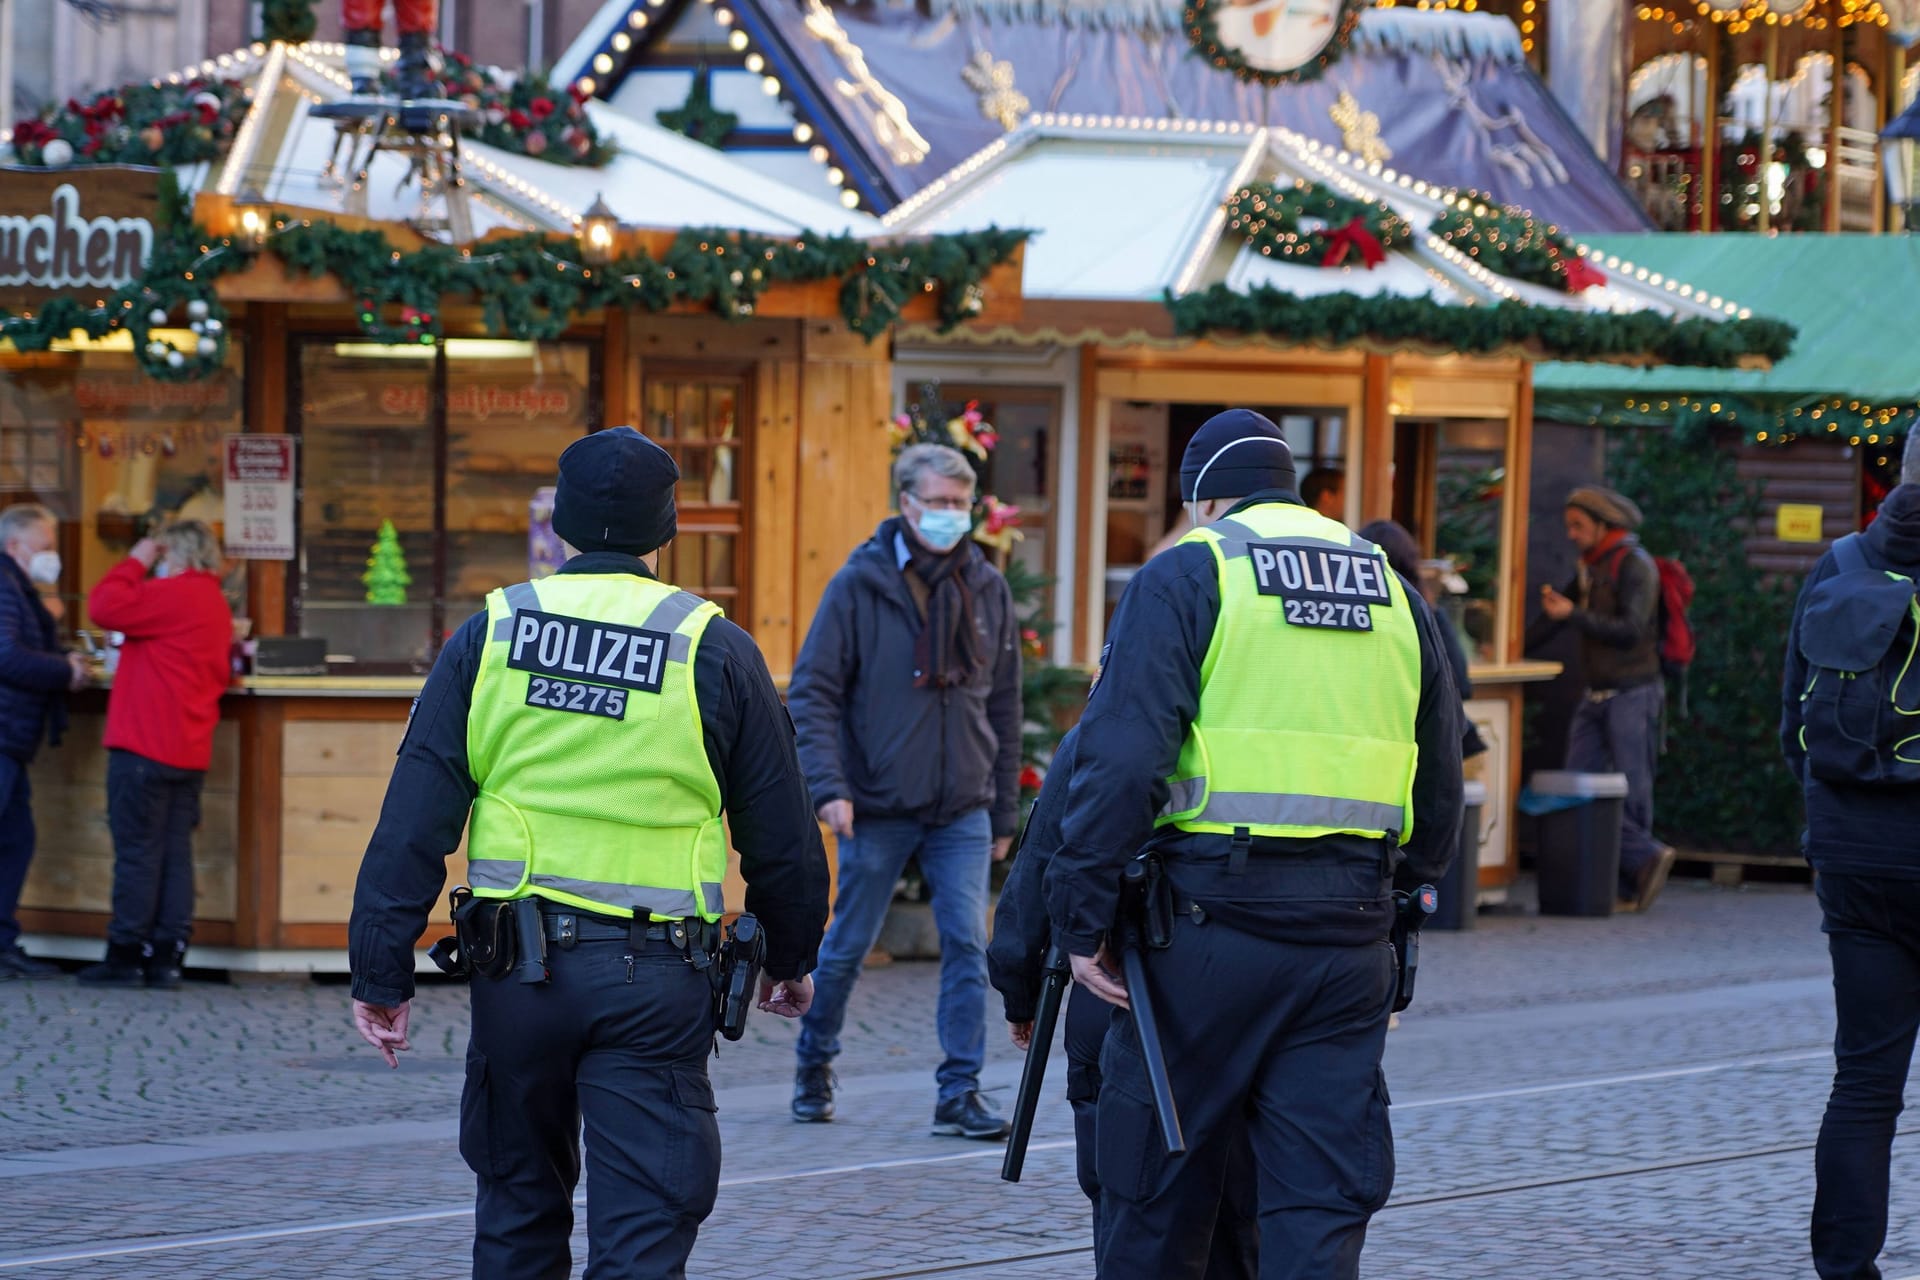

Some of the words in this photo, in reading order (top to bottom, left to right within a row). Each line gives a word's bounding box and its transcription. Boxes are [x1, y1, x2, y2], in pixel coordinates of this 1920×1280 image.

[1252, 548, 1388, 598] POLIZEI
[1284, 599, 1371, 628] 23276
[512, 616, 664, 684] POLIZEI
[528, 678, 625, 716] 23275
